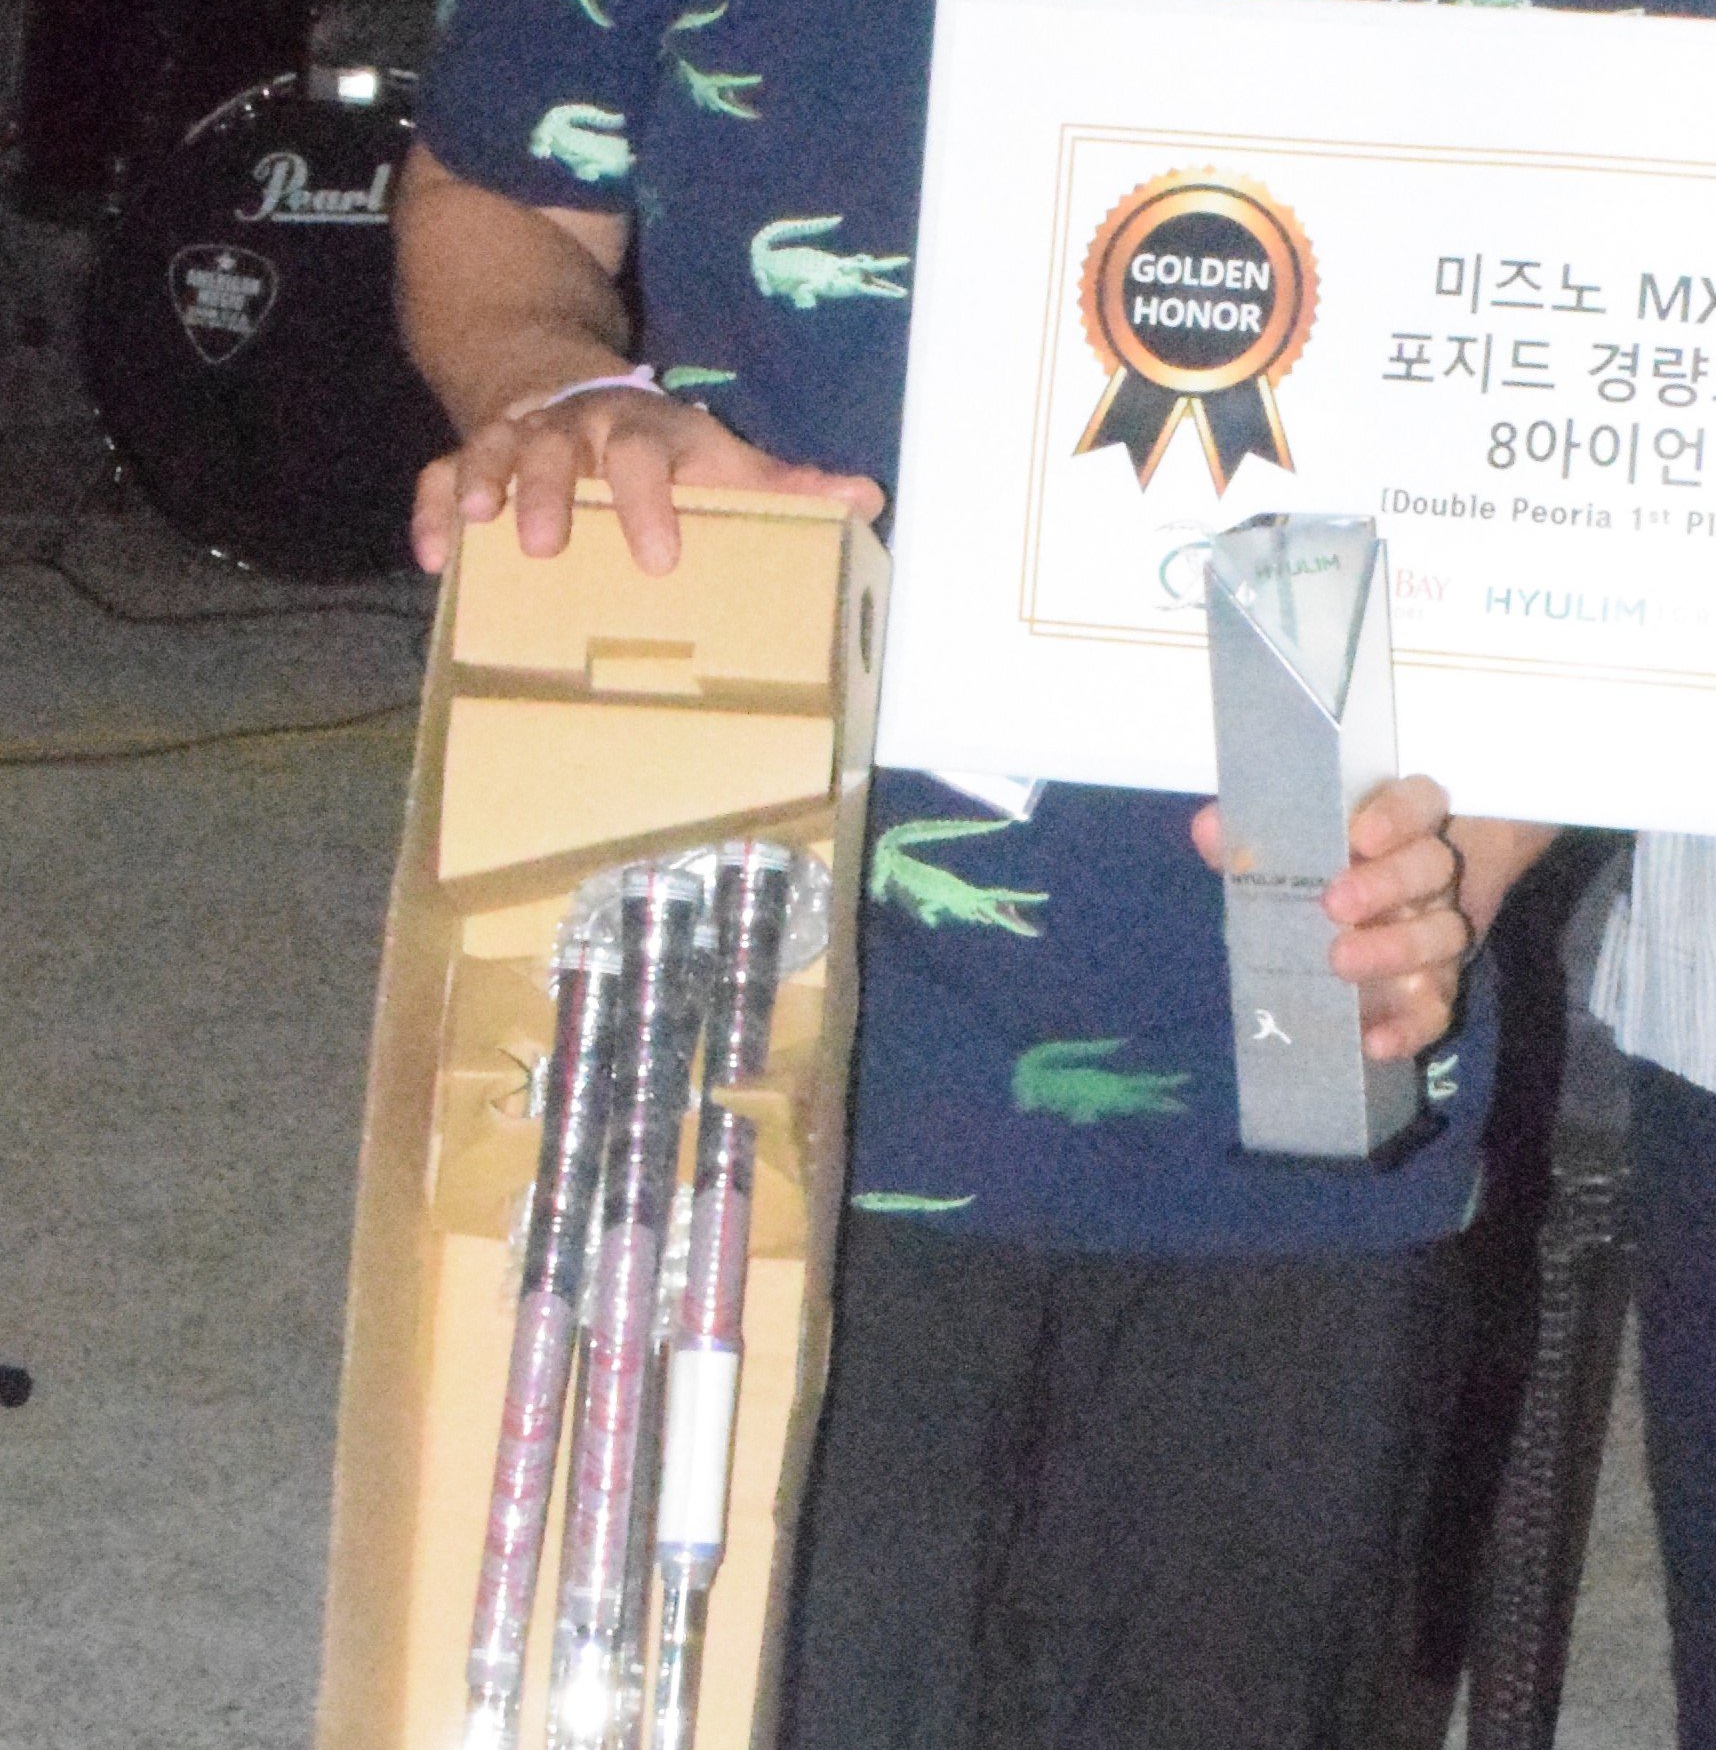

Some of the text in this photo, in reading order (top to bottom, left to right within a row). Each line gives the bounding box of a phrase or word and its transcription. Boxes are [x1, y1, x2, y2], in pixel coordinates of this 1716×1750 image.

[234, 152, 392, 223] Pearl
[1131, 253, 1271, 291] GOLDEN
[1435, 253, 1607, 314] 미즈노
[1133, 296, 1261, 333] HONOR
[1382, 332, 1556, 394] 포지드
[1486, 418, 1706, 488] 8아이언
[1512, 497, 1613, 529] Peoria
[1485, 586, 1648, 626] HYULIM
